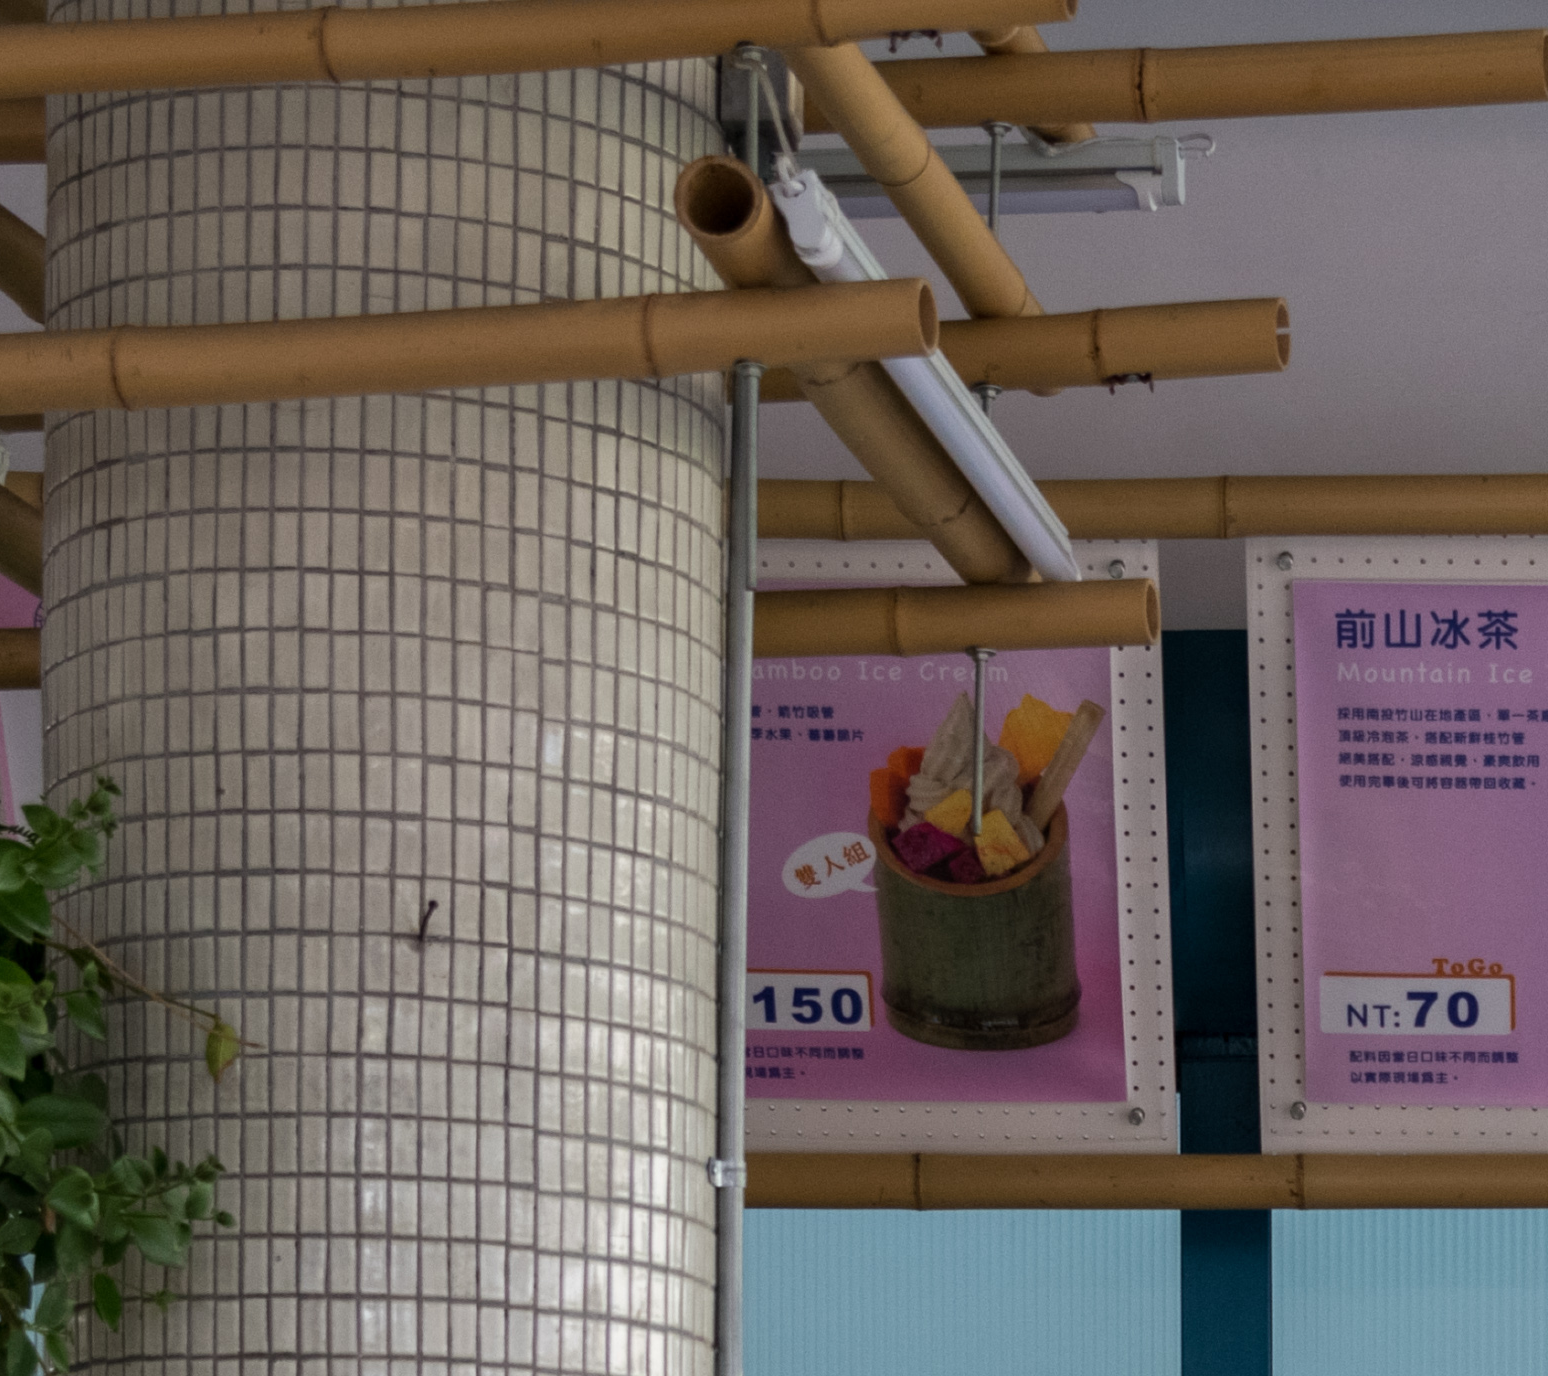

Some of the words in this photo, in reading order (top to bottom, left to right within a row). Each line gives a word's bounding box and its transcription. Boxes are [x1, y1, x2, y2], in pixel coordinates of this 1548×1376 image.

[1334, 608, 1519, 650] 前山冰茶
[750, 661, 842, 681] amboo
[859, 661, 902, 681] Ice
[1337, 661, 1471, 684] Mountain
[1488, 663, 1534, 684] Ice
[793, 840, 872, 891] 雙人組
[752, 986, 864, 1026] 150
